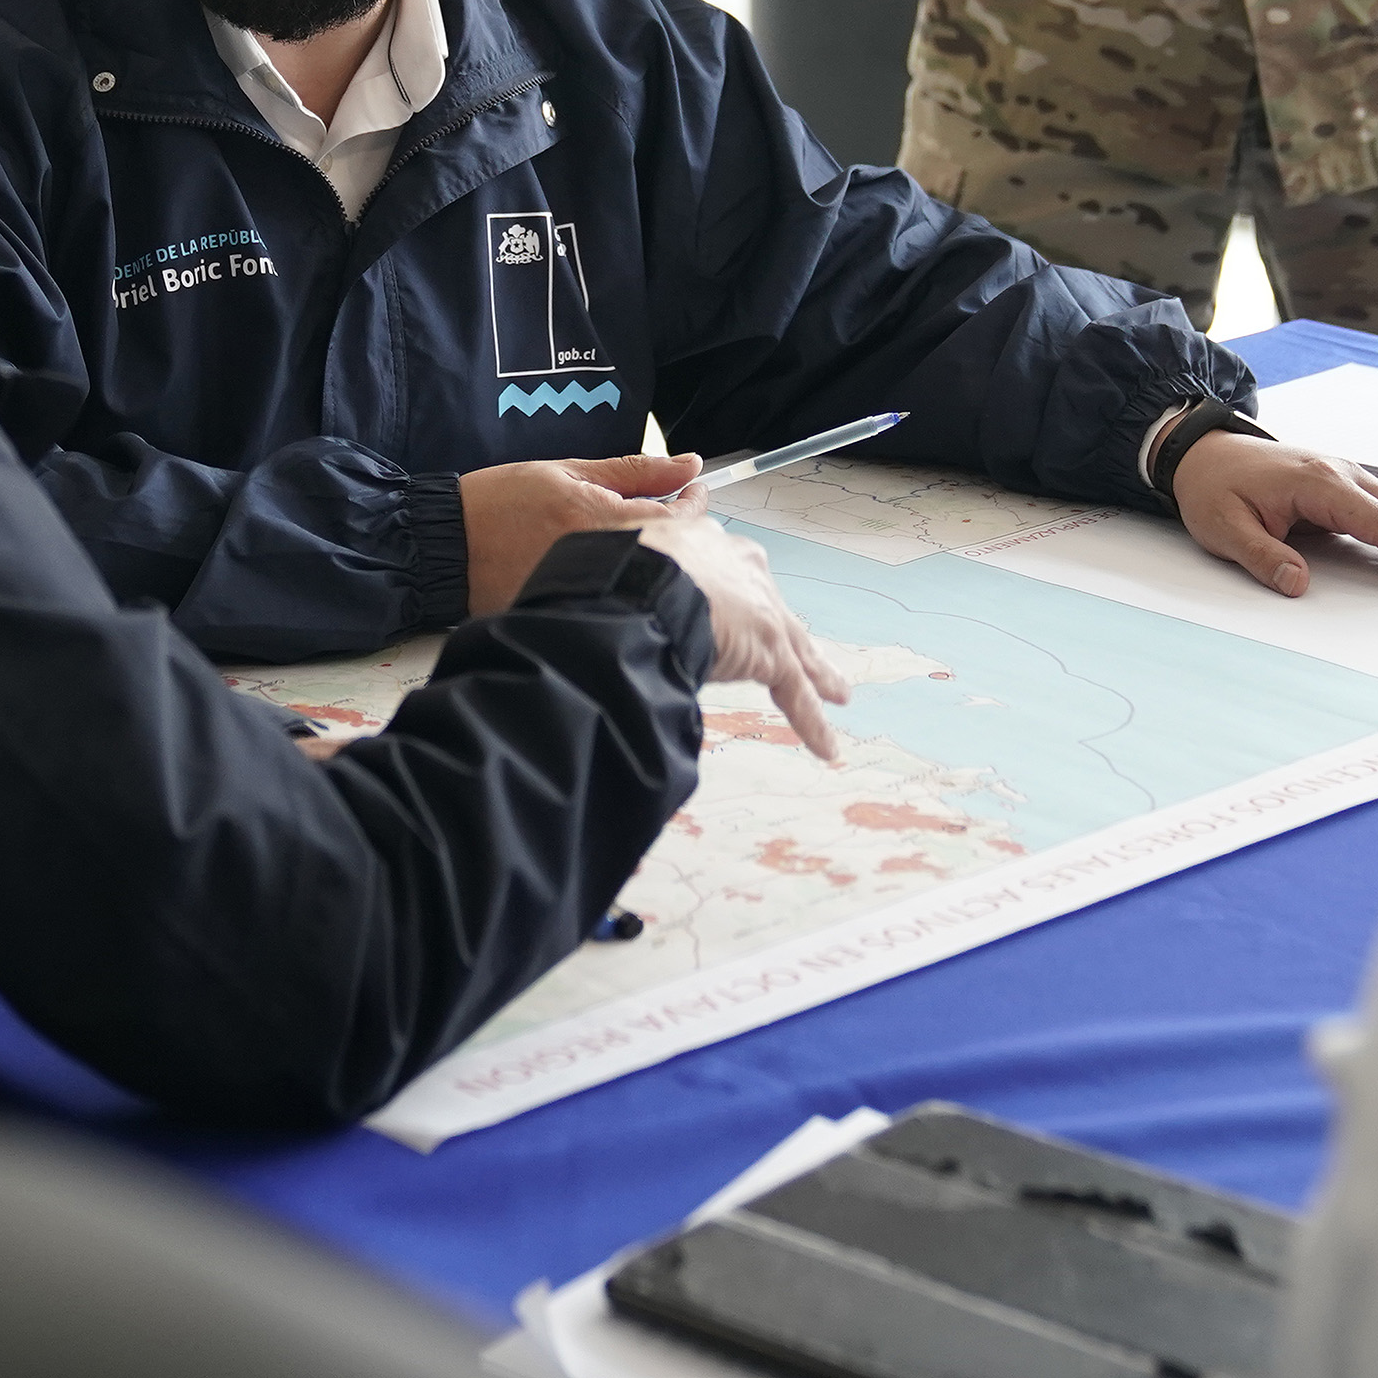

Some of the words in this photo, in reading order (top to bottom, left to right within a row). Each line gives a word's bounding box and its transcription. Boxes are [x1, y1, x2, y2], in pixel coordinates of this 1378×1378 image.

[155, 244, 178, 263] DE
[180, 239, 199, 257] LA
[162, 258, 222, 293] Boric
[557, 348, 596, 365] gob.cl
[964, 517, 1098, 558] EMPLAZAMIENTO
[1021, 810, 1238, 891] FORESTALES
[859, 887, 1022, 951] ACTIVOS
[798, 943, 865, 972] EN
[624, 966, 801, 1032] OCTAVA
